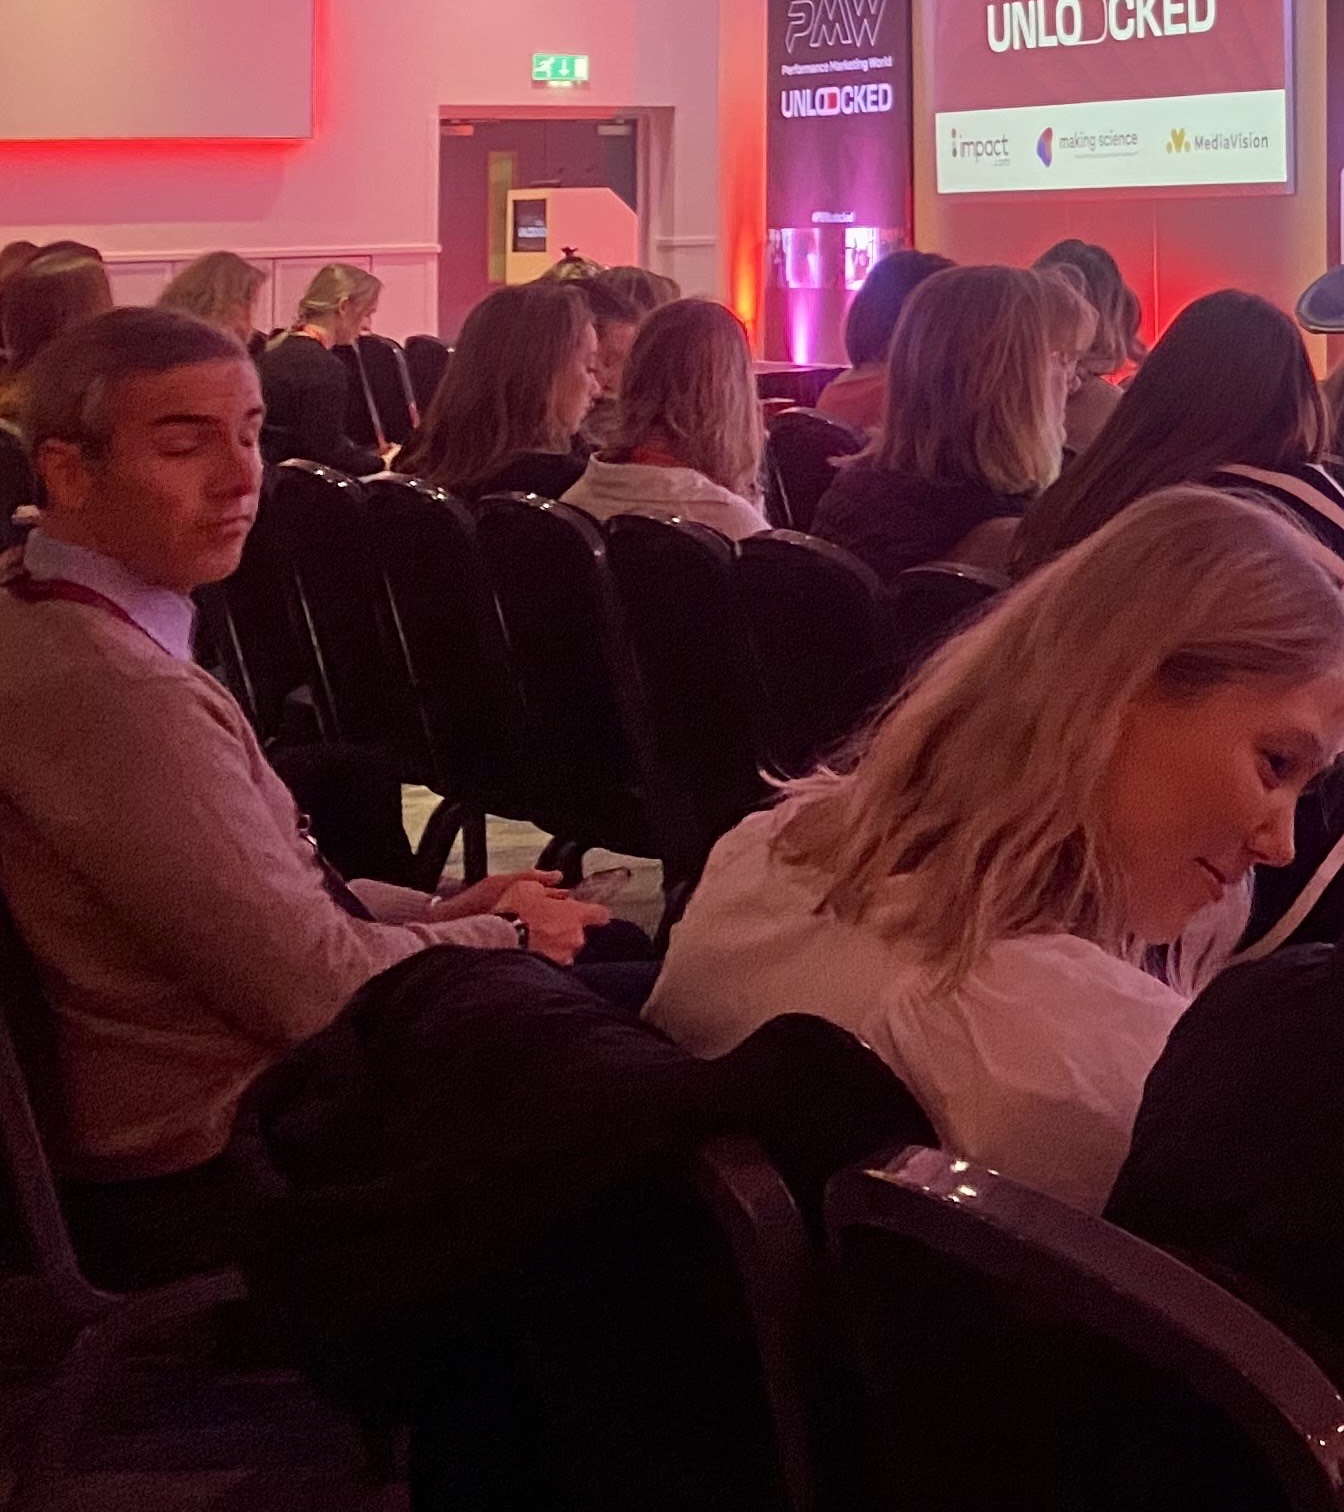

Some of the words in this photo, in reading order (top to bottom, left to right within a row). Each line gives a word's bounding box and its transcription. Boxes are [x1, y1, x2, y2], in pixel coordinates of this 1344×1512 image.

[781, 83, 892, 118] UNLOCKED
[1059, 131, 1095, 151] making
[1099, 129, 1138, 147] science
[1194, 134, 1269, 151] MediaVision
